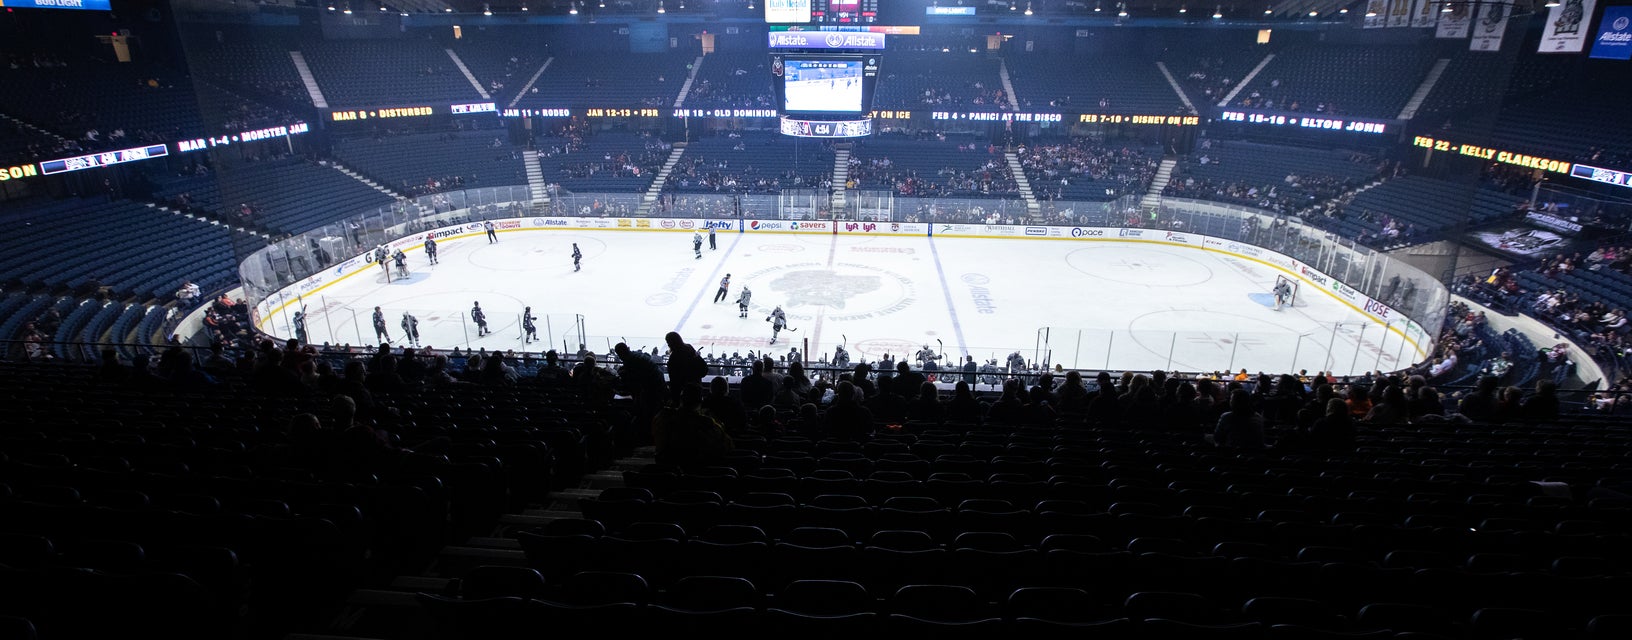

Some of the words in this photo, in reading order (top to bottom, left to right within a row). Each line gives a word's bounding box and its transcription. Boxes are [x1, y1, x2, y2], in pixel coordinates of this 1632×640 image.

[1599, 32, 1632, 42] Allstate
[332, 111, 357, 121] MAR
[359, 110, 367, 119] 8
[378, 107, 433, 118] DISTURBED
[542, 109, 570, 117] RODEO
[606, 109, 631, 117] 12-13
[641, 109, 658, 117] PBR
[1015, 113, 1032, 121] THE
[1035, 113, 1062, 121] DISCO
[1080, 114, 1098, 122] FEB
[1132, 116, 1165, 124] DISNEY
[1167, 116, 1181, 124] ON
[1183, 117, 1199, 125] ICE
[1222, 112, 1245, 121] FEB
[1248, 114, 1286, 125] 15-16
[1300, 118, 1343, 130] ELTON
[1345, 122, 1385, 134] JOHN
[815, 125, 830, 135] 4:54
[178, 138, 207, 152] MAR
[209, 135, 230, 147] 1-4
[240, 126, 288, 142] MONSTER
[289, 123, 309, 135] JAM
[1413, 136, 1434, 149] FEB
[1434, 140, 1450, 151] 22
[1459, 144, 1496, 160] KELLY
[1497, 151, 1571, 174] CLARKSON
[0, 164, 38, 181] SON
[705, 220, 732, 229] Hefty
[845, 222, 859, 231] lyft
[863, 223, 877, 232] lyft
[434, 226, 464, 239] impact
[1081, 229, 1104, 237] pace
[1306, 267, 1327, 286] impact
[1363, 298, 1390, 319] ROSE
